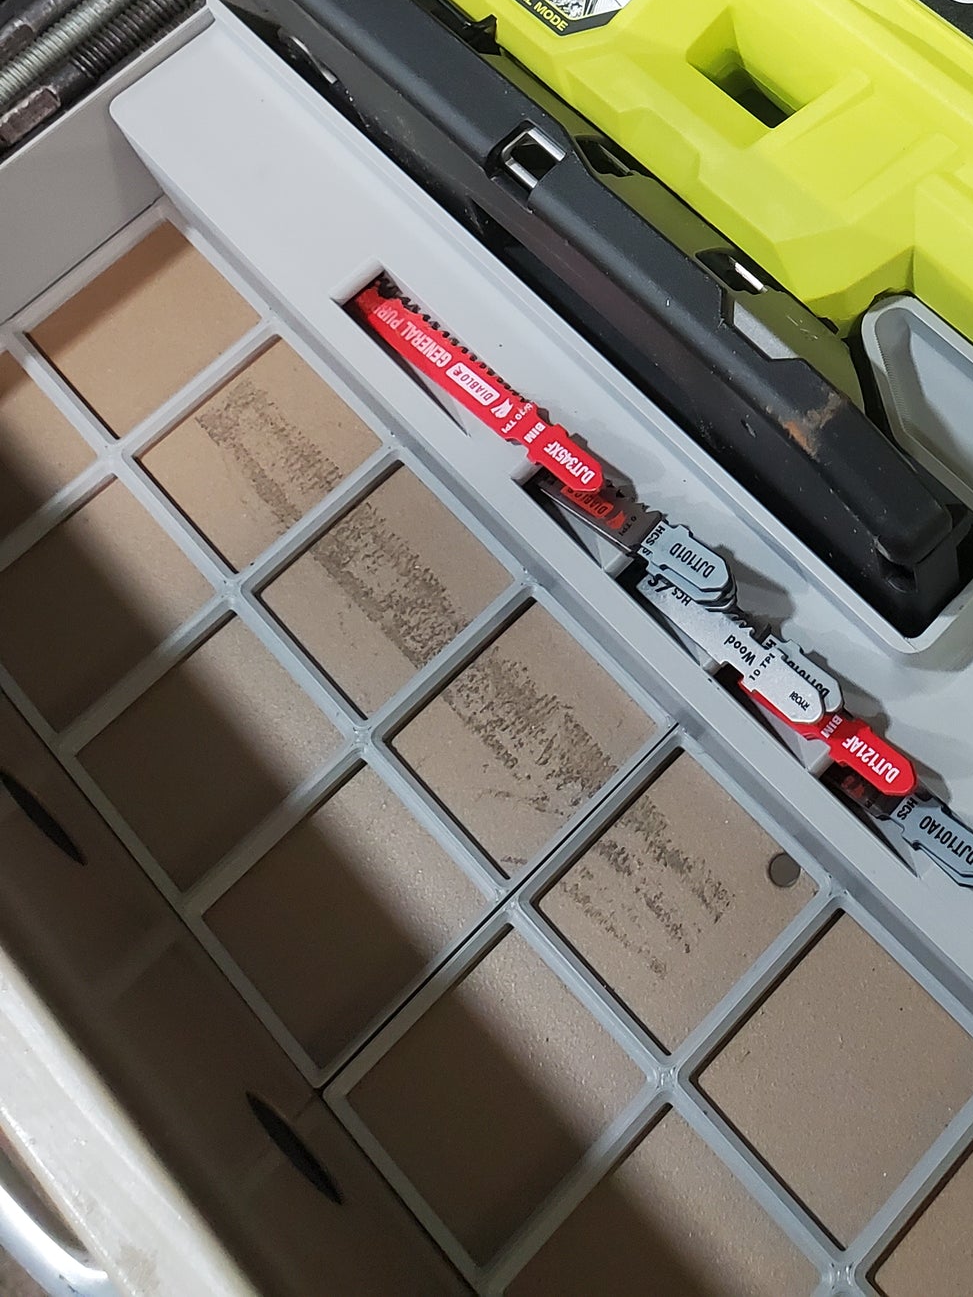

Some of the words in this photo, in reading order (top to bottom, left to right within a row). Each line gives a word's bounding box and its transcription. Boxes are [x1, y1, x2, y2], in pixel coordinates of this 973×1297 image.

[533, 1, 568, 32] MODE
[400, 322, 452, 369] GENERAL
[459, 371, 494, 401] DIABLO
[523, 422, 545, 444] BIM
[544, 440, 596, 485] DJT345XF
[645, 525, 665, 546] HCS
[670, 542, 716, 579] DJT101D
[724, 634, 756, 666] Wood
[788, 690, 811, 711] RYOBI
[820, 714, 843, 739] BIM
[842, 736, 900, 785] DJT121AF
[896, 796, 918, 820] HCS
